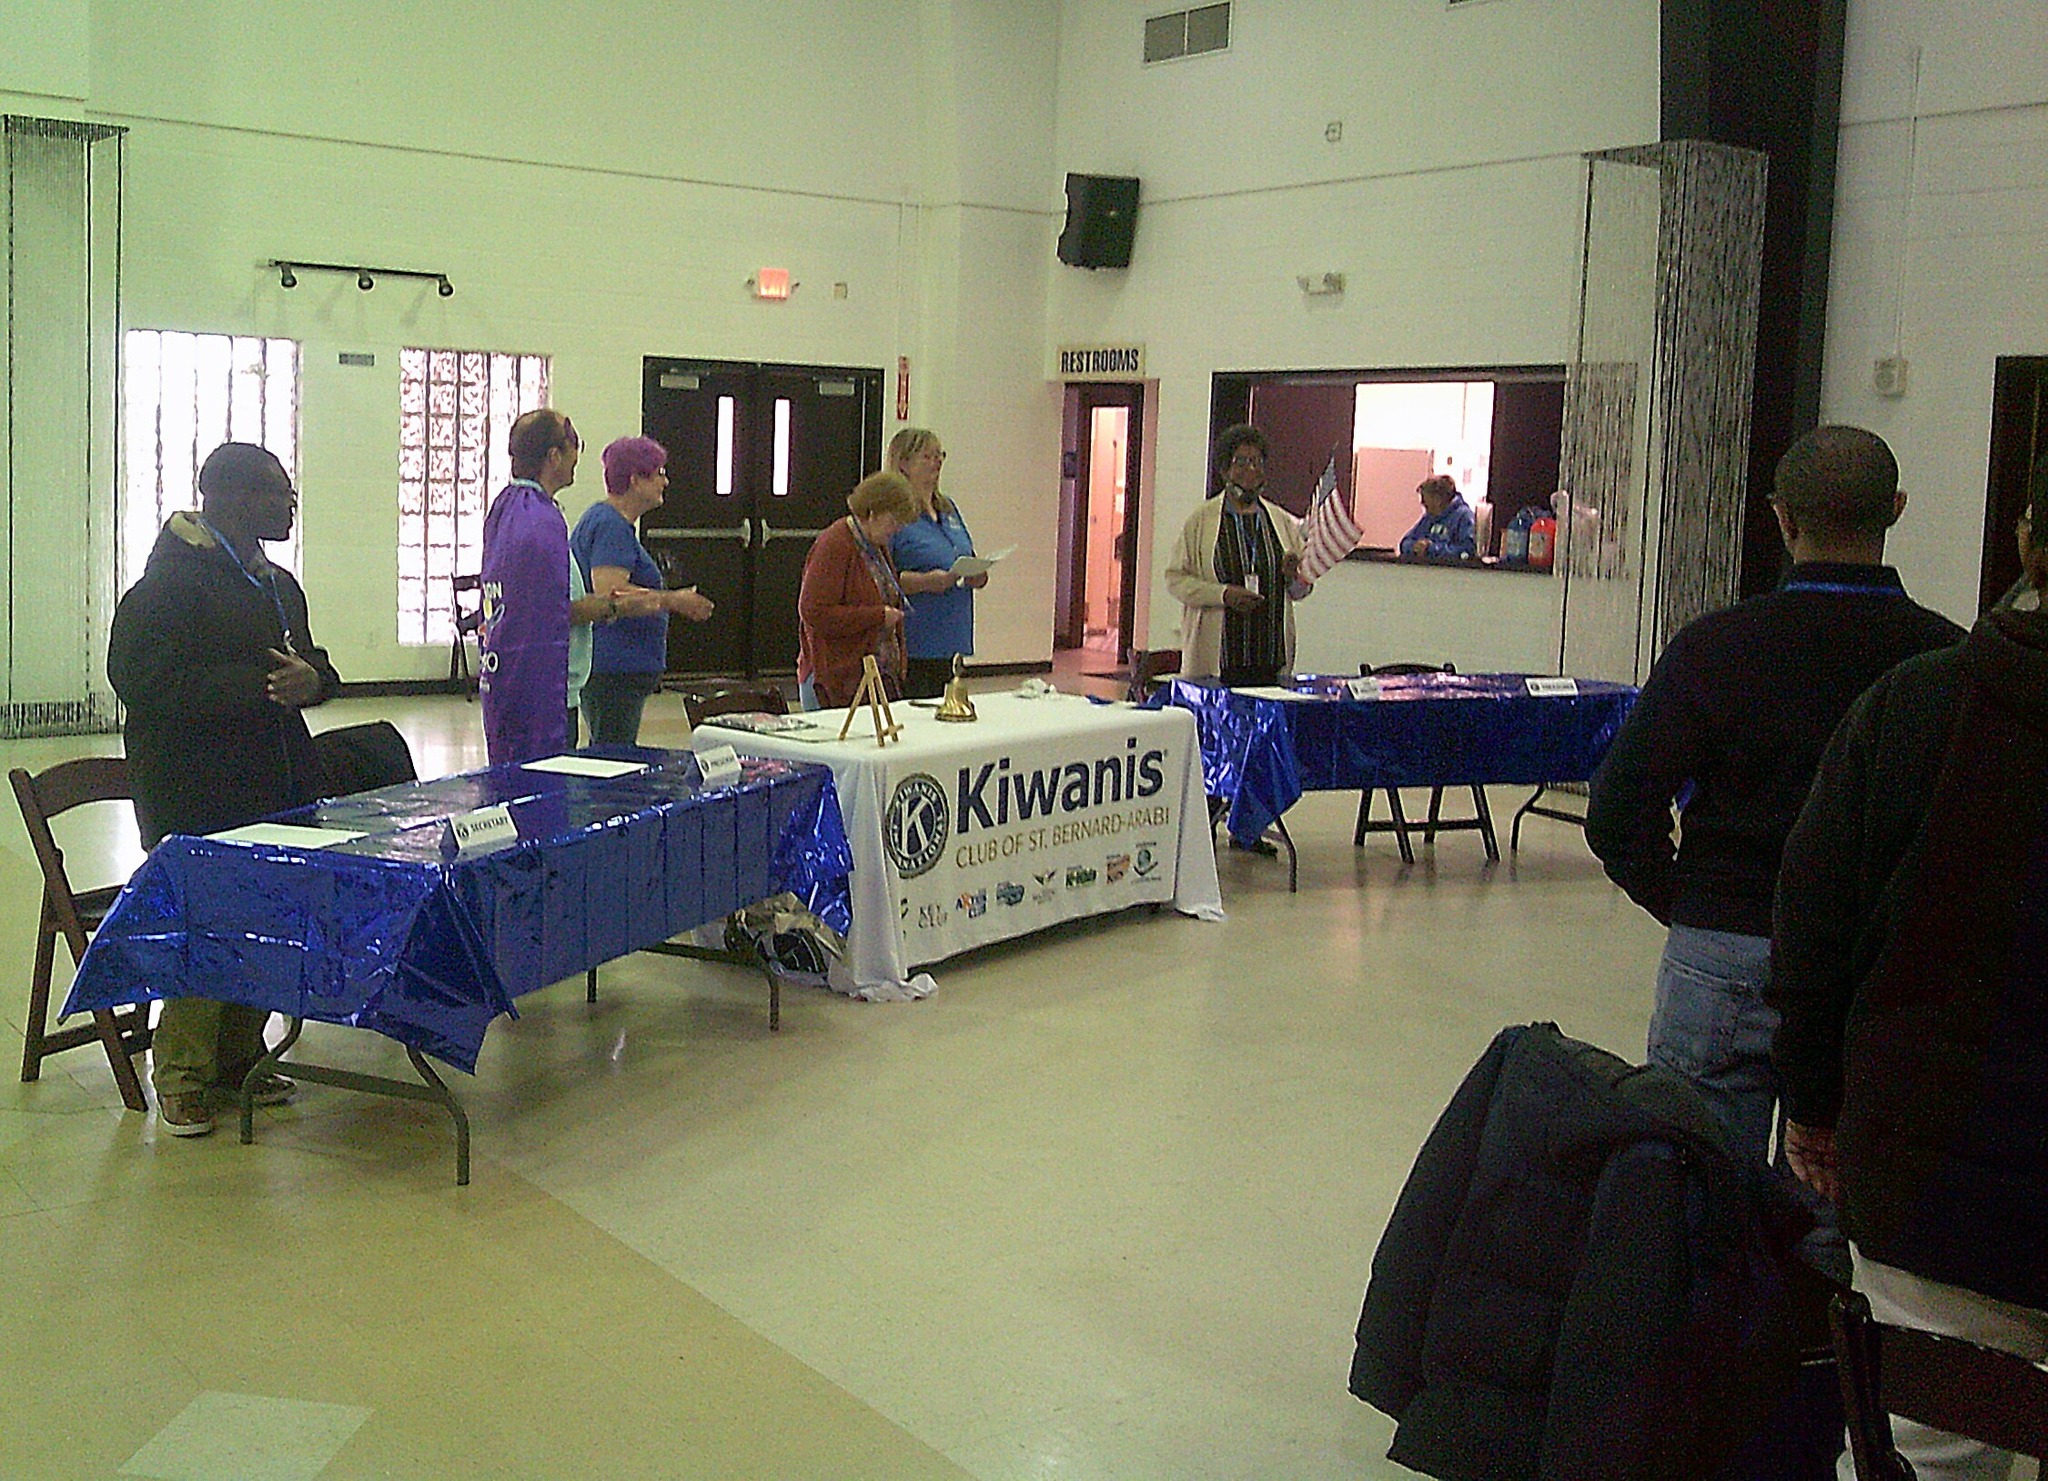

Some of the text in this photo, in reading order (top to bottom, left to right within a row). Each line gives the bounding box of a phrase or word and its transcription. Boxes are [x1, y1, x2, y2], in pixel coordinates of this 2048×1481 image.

[1061, 348, 1139, 373] RESTROOMS
[957, 737, 1164, 834] Kiwanis
[901, 795, 929, 858] K
[956, 839, 998, 869] CLUB
[1002, 832, 1024, 857] OF
[1029, 827, 1048, 852] ST.
